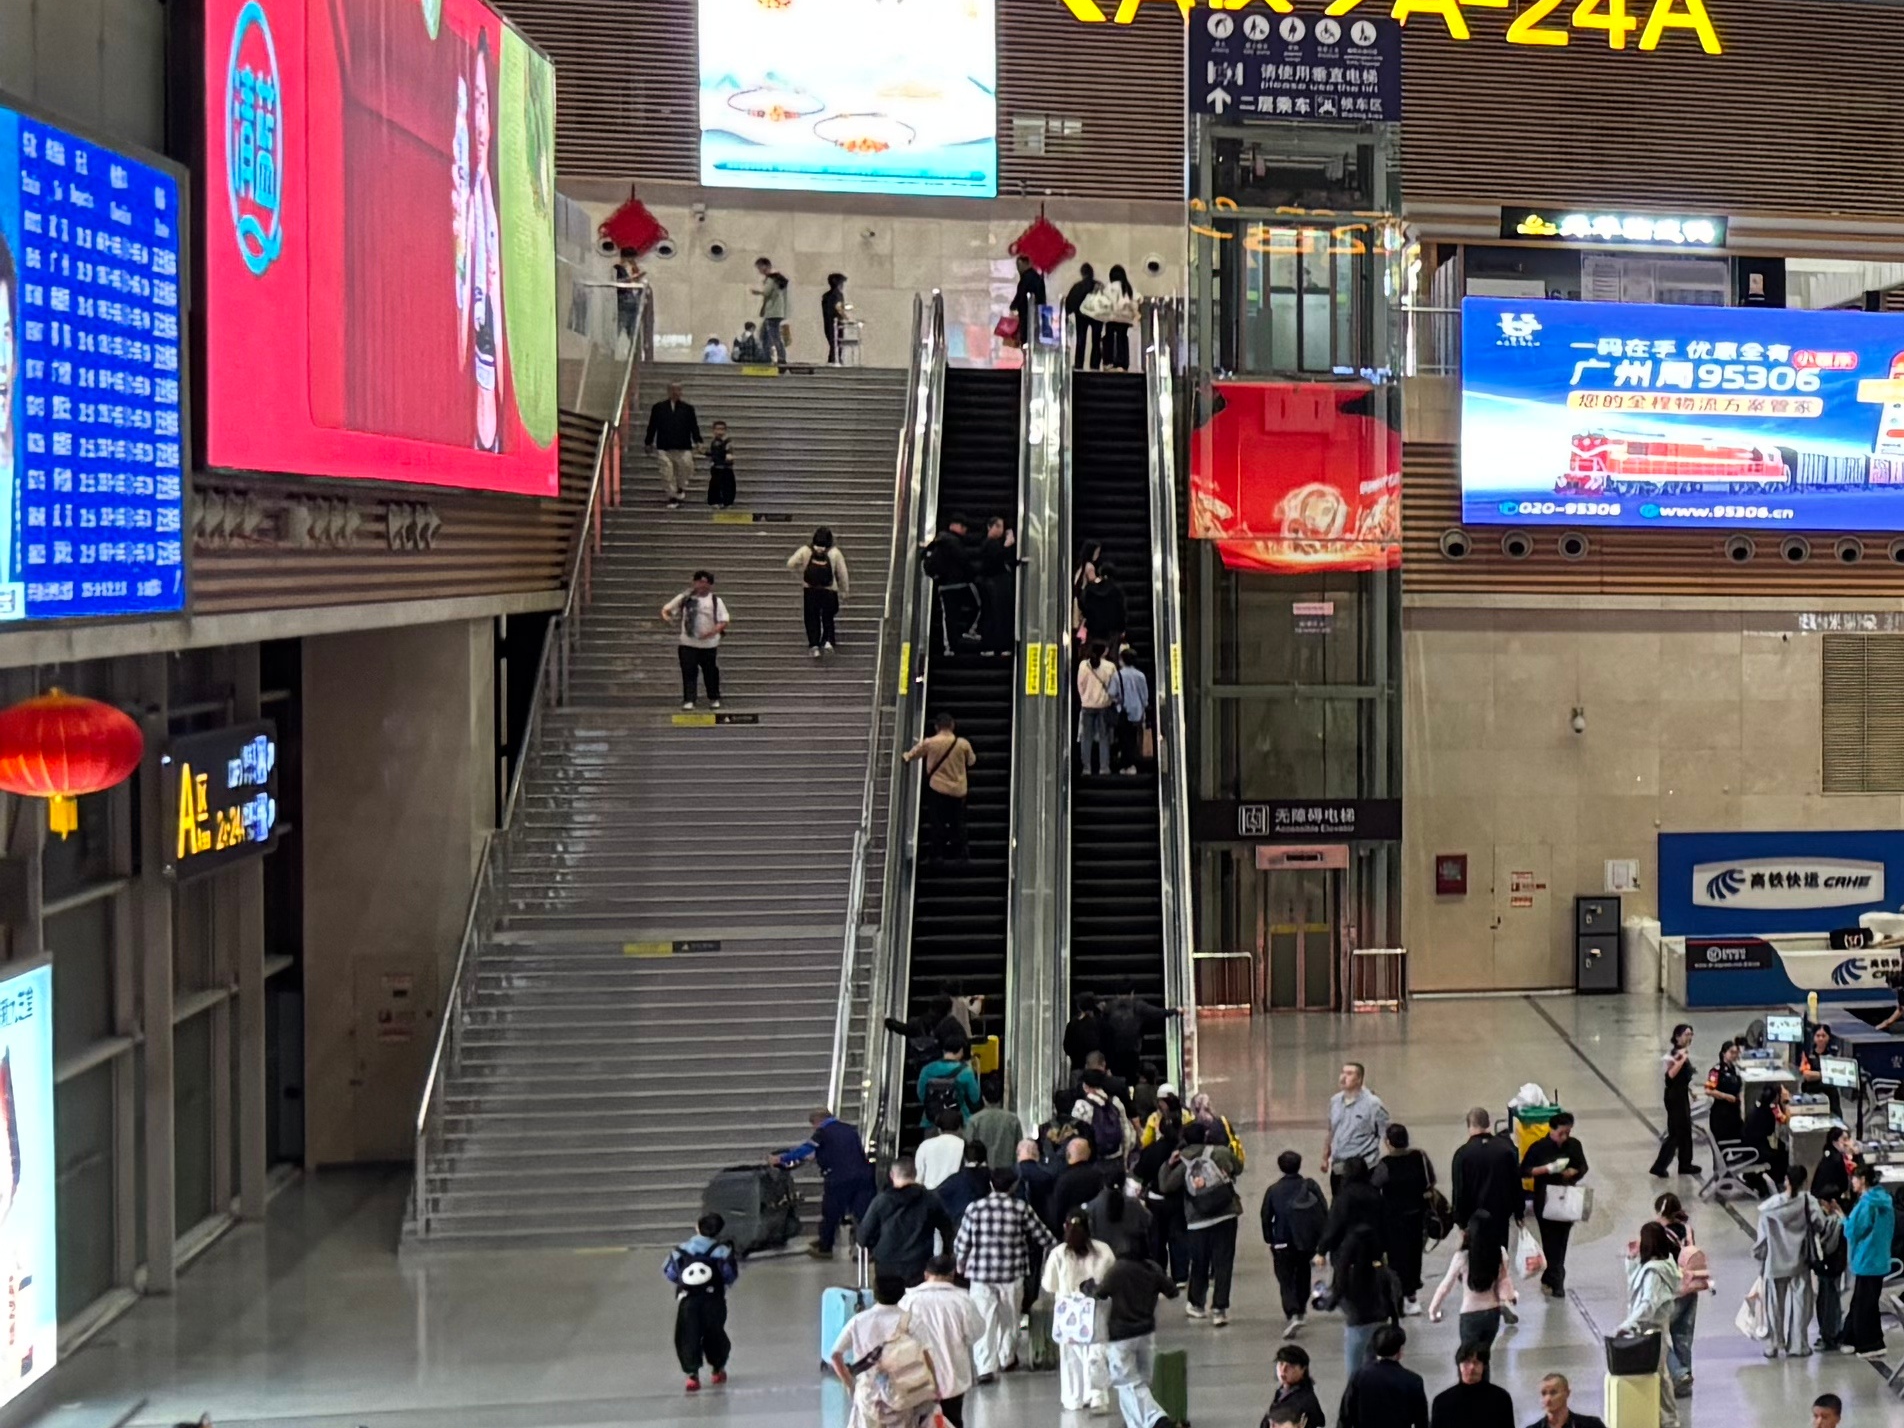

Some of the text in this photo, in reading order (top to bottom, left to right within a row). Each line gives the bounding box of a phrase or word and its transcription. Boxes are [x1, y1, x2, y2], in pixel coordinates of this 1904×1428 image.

[1261, 63, 1378, 84] 请使用垂直电梯
[1570, 338, 1676, 359] 一码在手
[1569, 358, 1821, 391] 广州局95306
[1519, 502, 1621, 517] 020-95306
[1660, 505, 1794, 520] www.95306.cn
[1275, 808, 1355, 823] 无障碍电梯
[1751, 871, 1819, 889] 高铁快运
